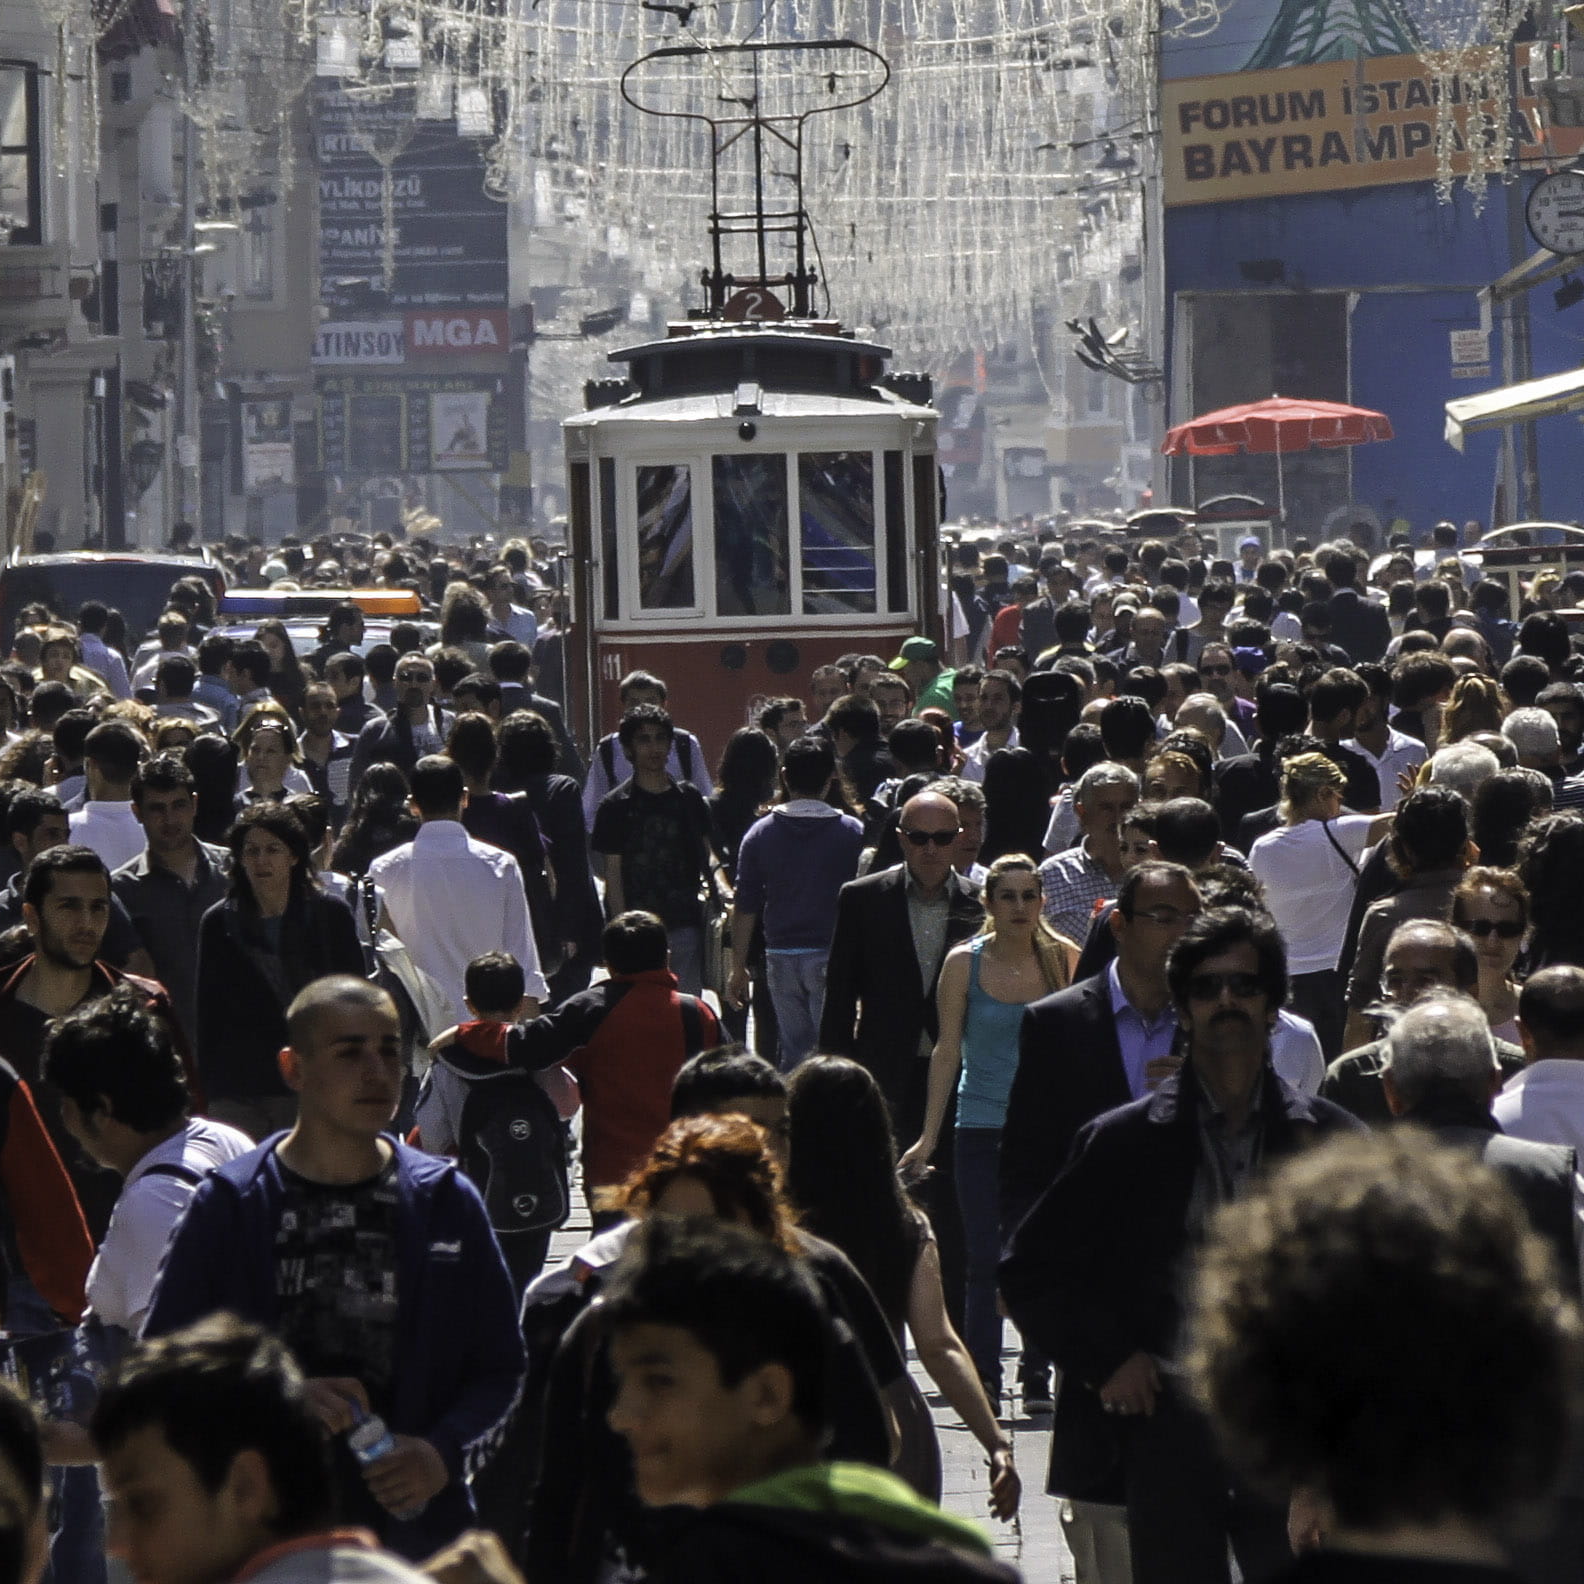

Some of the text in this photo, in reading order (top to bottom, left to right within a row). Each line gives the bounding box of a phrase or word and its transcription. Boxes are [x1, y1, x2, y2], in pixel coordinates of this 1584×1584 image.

[1178, 66, 1536, 135] FORUM İSTANL
[745, 292, 763, 319] 2
[413, 318, 499, 347] MGA
